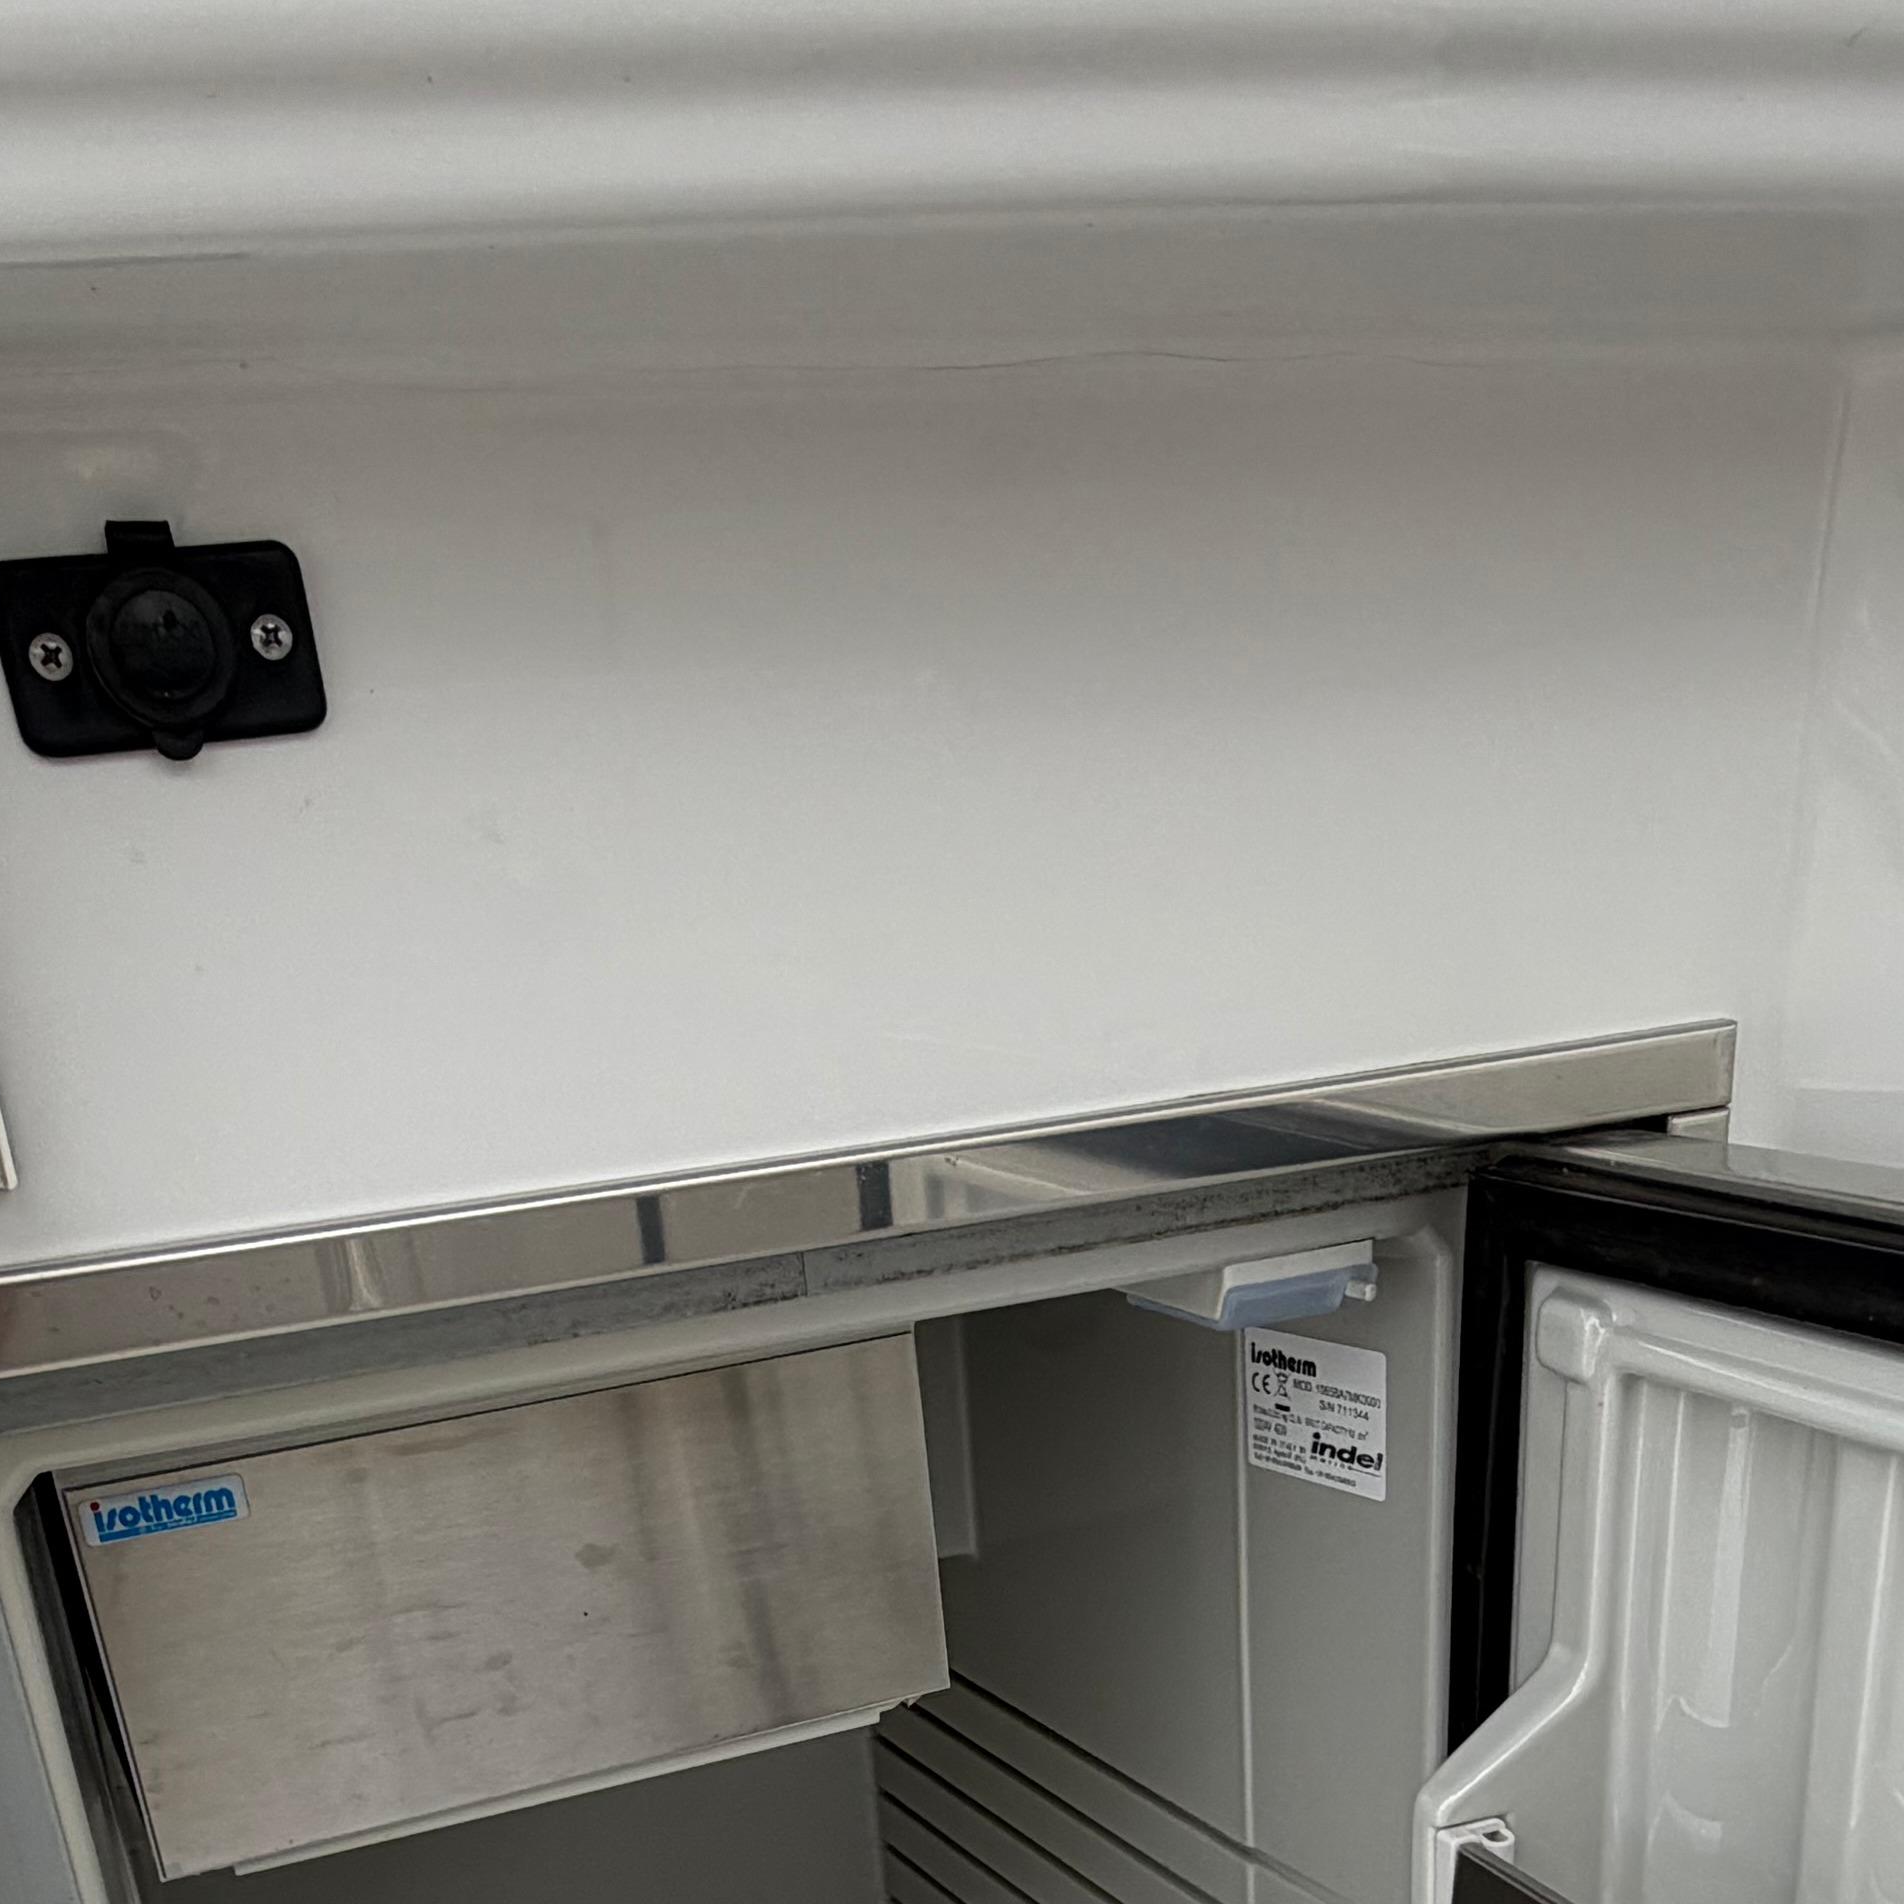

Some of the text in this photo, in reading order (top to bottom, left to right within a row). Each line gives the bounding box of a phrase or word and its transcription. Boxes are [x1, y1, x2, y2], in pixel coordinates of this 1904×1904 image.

[1250, 1341, 1317, 1378] isotherm
[1310, 1431, 1384, 1471] indel
[89, 1487, 238, 1533] isotherm
